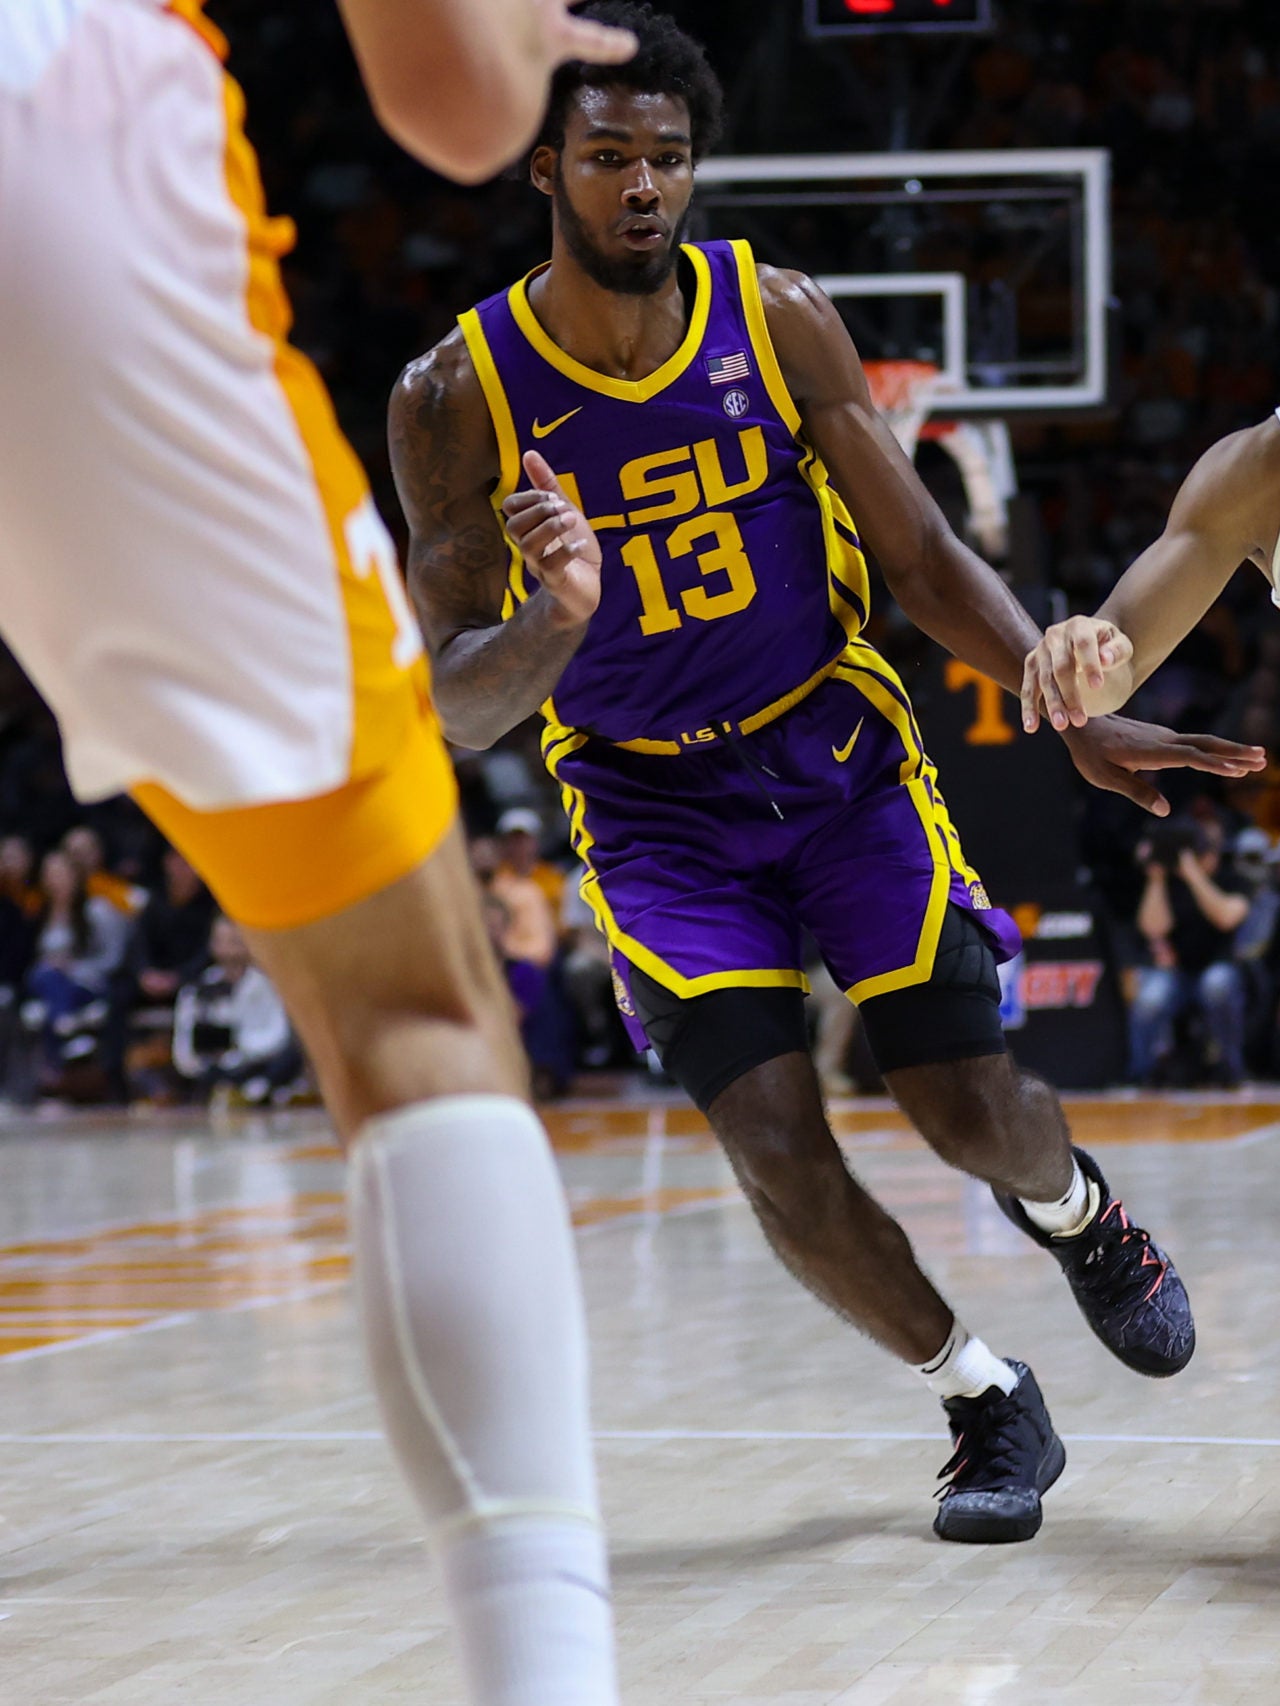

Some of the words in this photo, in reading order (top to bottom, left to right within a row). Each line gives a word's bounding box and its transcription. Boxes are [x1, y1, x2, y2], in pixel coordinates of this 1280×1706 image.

[725, 391, 747, 418] SEC
[553, 426, 769, 531] LSU
[620, 511, 757, 636] 13
